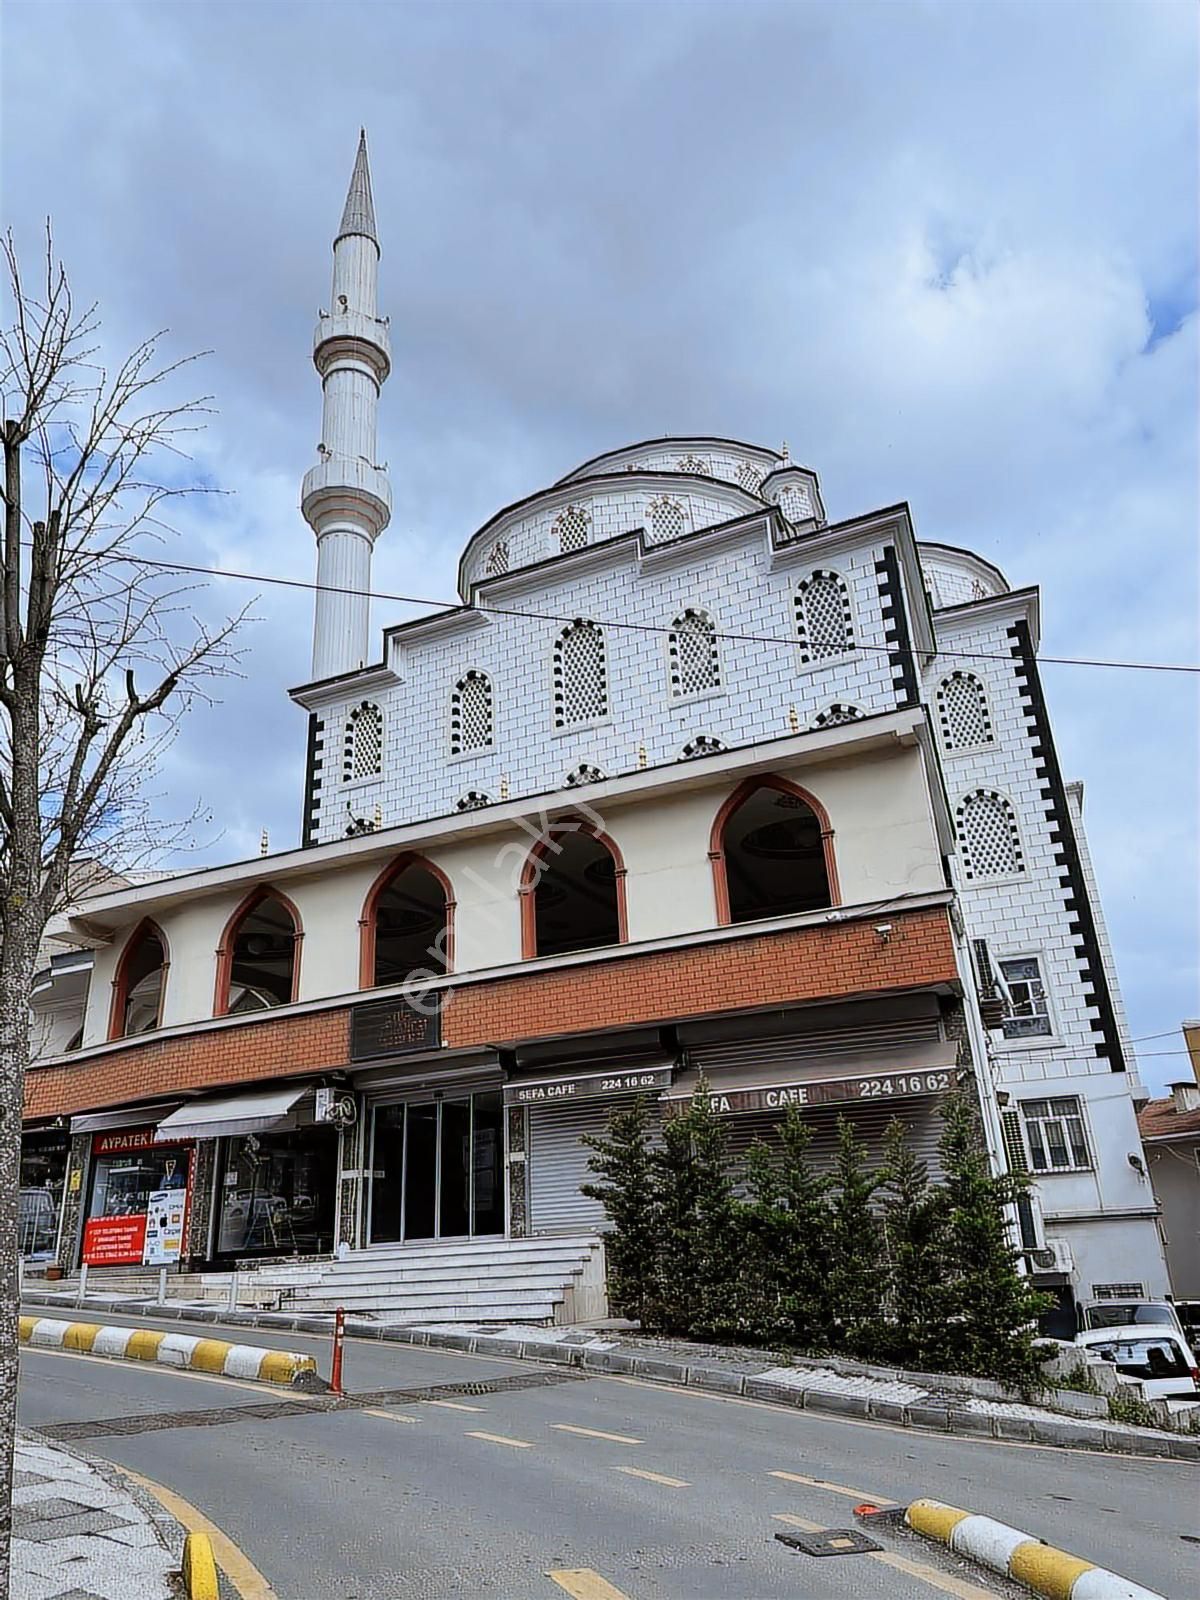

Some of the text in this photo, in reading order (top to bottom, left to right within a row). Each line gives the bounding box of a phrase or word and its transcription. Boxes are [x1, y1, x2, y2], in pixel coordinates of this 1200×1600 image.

[518, 1074, 655, 1100] SEFA CAFE 224 16 62
[691, 1073, 950, 1114] FA CAFE 224 16 62
[101, 1131, 149, 1151] AYPATEK
